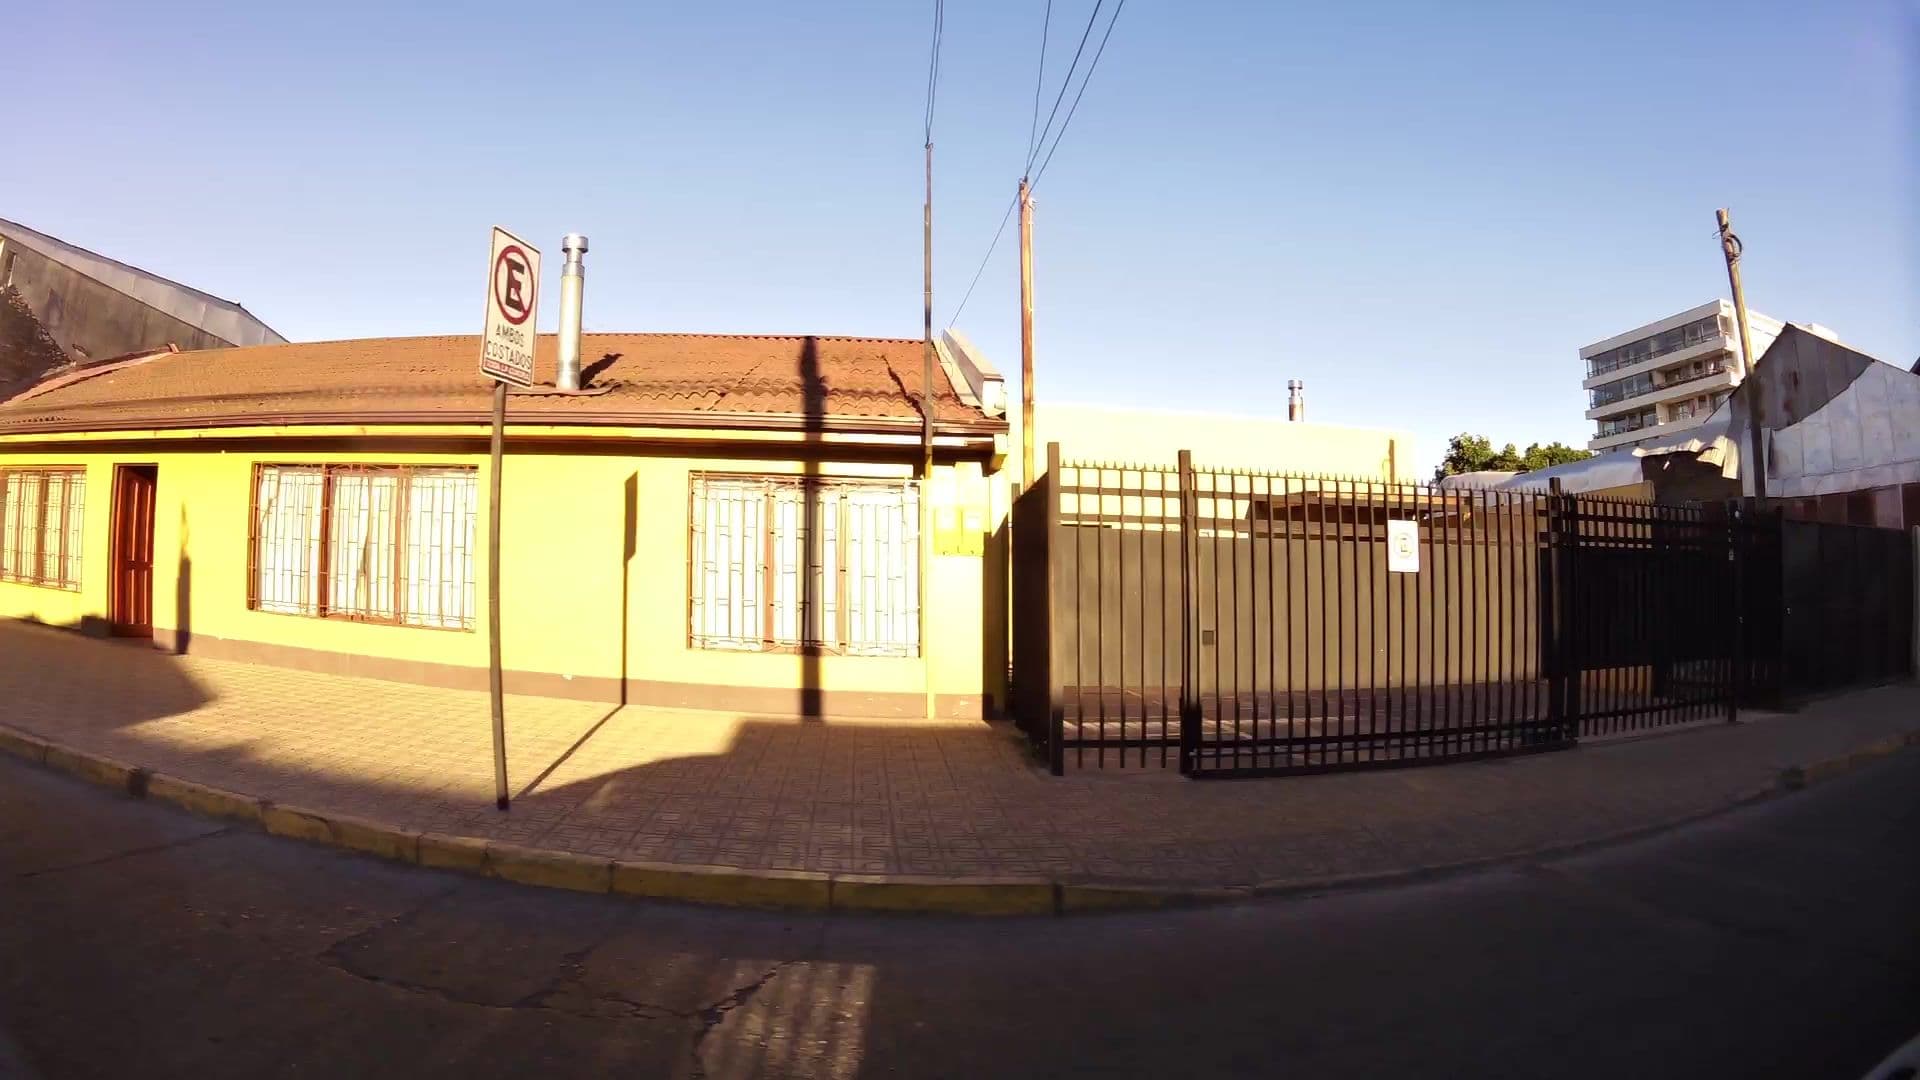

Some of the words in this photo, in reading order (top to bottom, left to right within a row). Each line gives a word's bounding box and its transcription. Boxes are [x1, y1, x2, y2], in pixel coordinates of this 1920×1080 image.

[505, 257, 524, 312] E
[496, 323, 525, 348] AMBOS
[487, 340, 533, 370] COSTADOS
